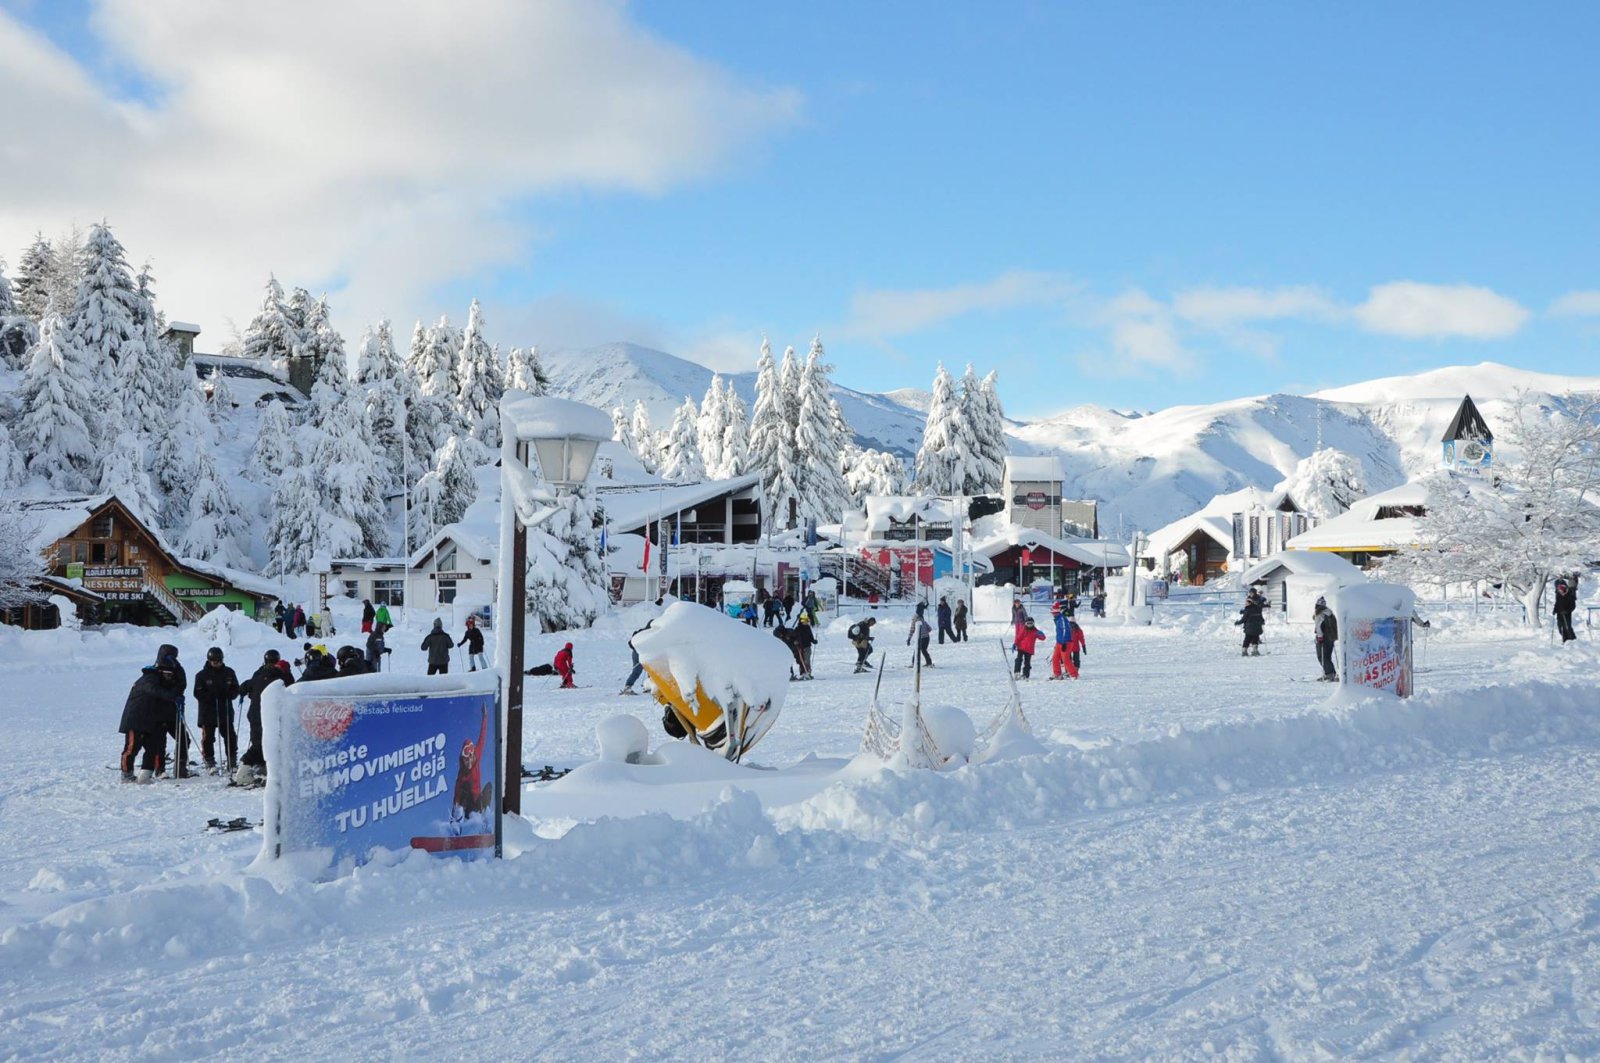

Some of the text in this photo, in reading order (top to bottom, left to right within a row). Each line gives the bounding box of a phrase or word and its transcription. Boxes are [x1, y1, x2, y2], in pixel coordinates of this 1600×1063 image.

[84, 580, 138, 589] NESTOR SKI
[121, 592, 130, 600] DE
[130, 592, 144, 600] SKI
[392, 703, 424, 713] felicidad
[300, 733, 446, 798] EN MOVIMIENTO
[395, 750, 446, 792] y dejá
[335, 774, 448, 832] TU HUELLA
